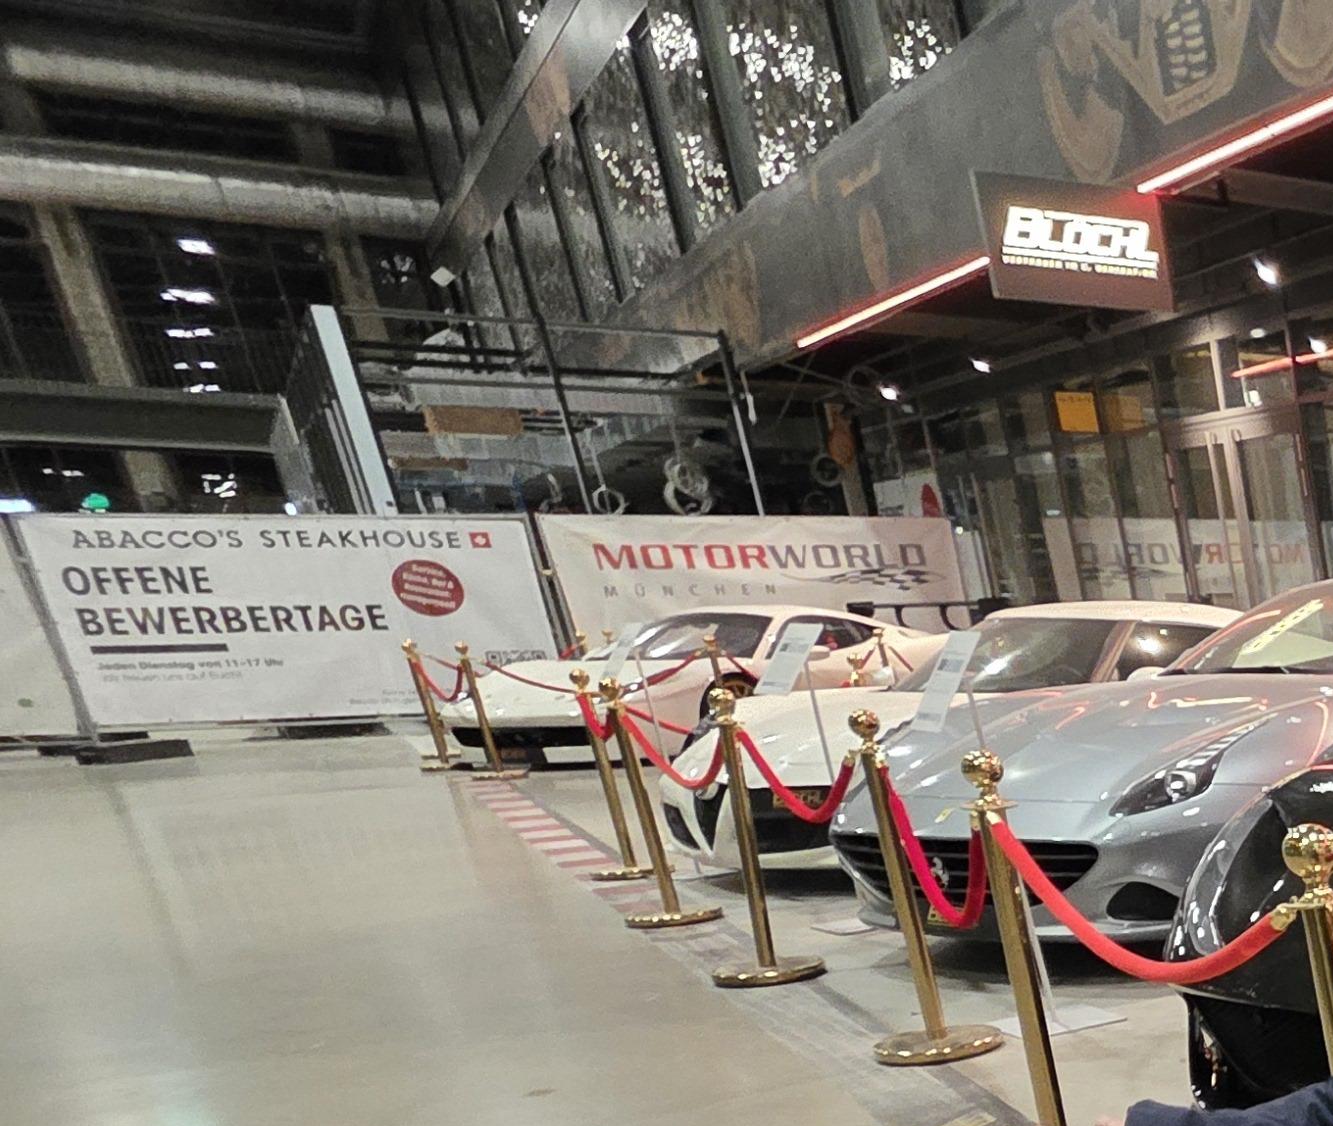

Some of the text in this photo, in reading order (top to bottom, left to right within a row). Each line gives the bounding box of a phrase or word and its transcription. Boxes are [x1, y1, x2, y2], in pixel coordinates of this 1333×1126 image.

[71, 529, 462, 550] ABACCO'S STEAKHOUSE
[592, 542, 927, 571] MOTORWORLD
[61, 565, 214, 597] OFFENE
[603, 582, 777, 598] MÜNCHEN
[75, 604, 389, 637] BEWERBERTAGE
